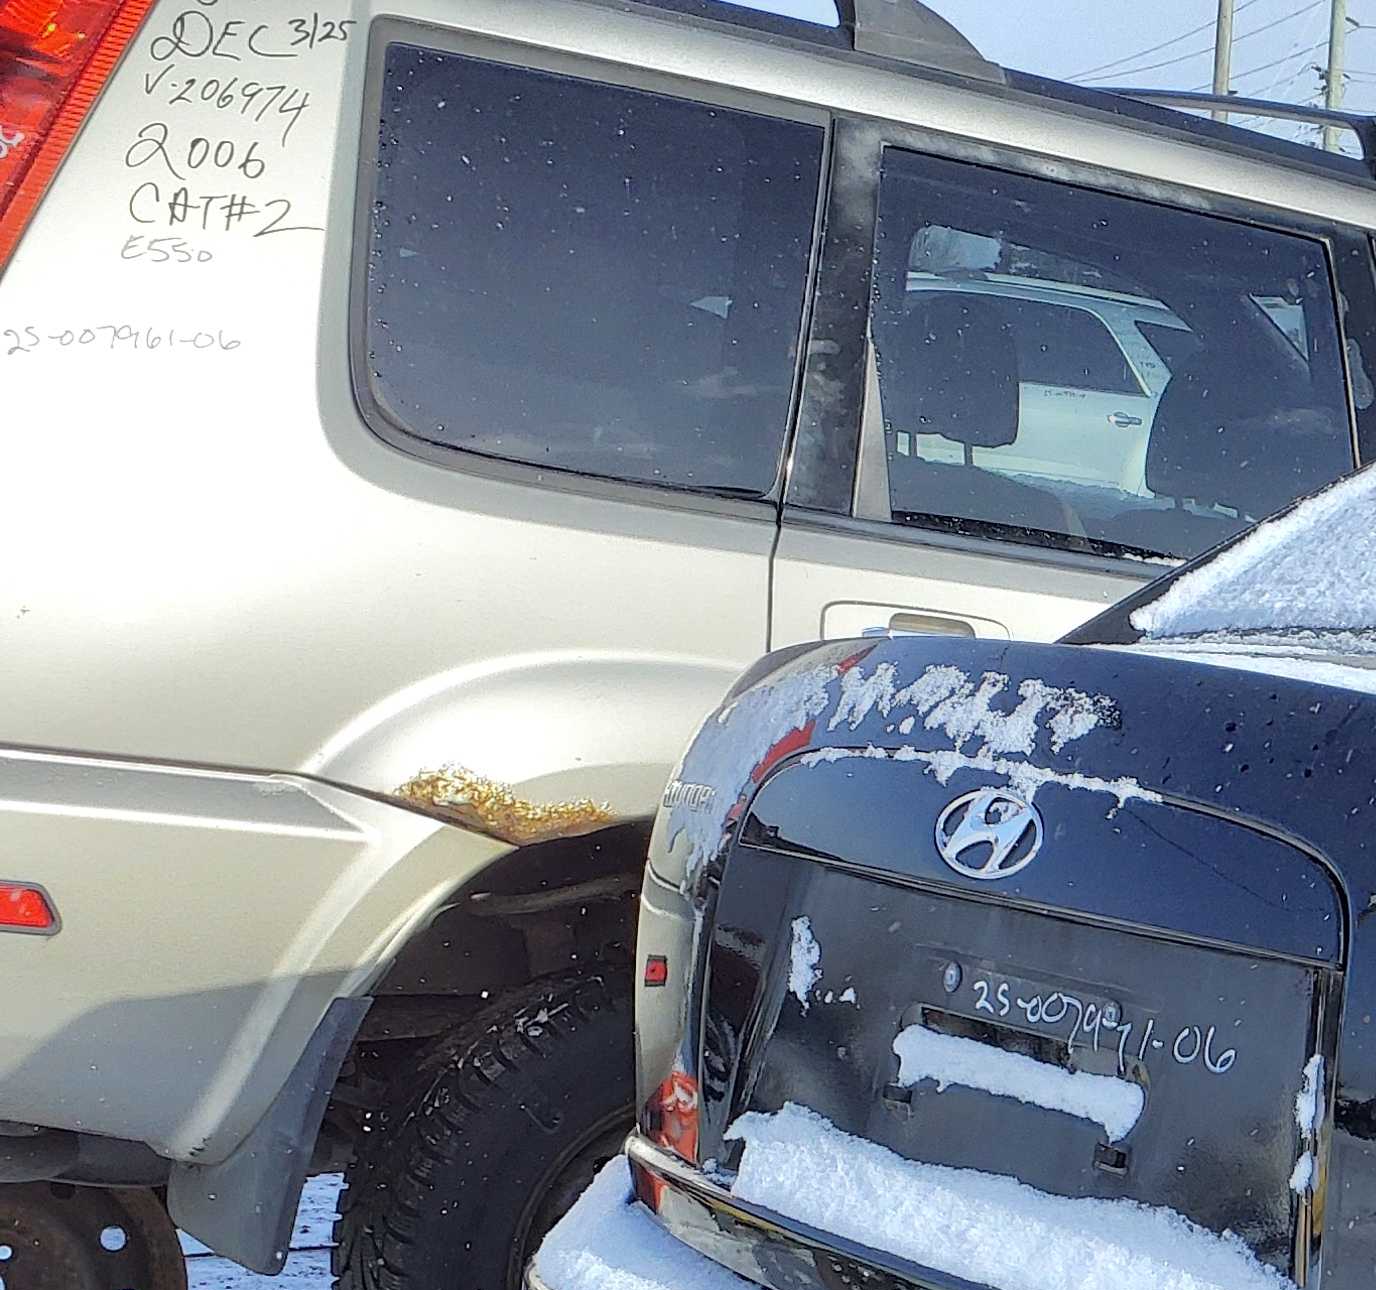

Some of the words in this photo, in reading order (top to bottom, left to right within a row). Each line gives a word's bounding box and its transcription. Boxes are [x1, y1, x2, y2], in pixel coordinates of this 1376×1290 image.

[149, 9, 299, 62] DEC
[124, 122, 266, 181] 2006
[128, 182, 326, 238] CAT#2
